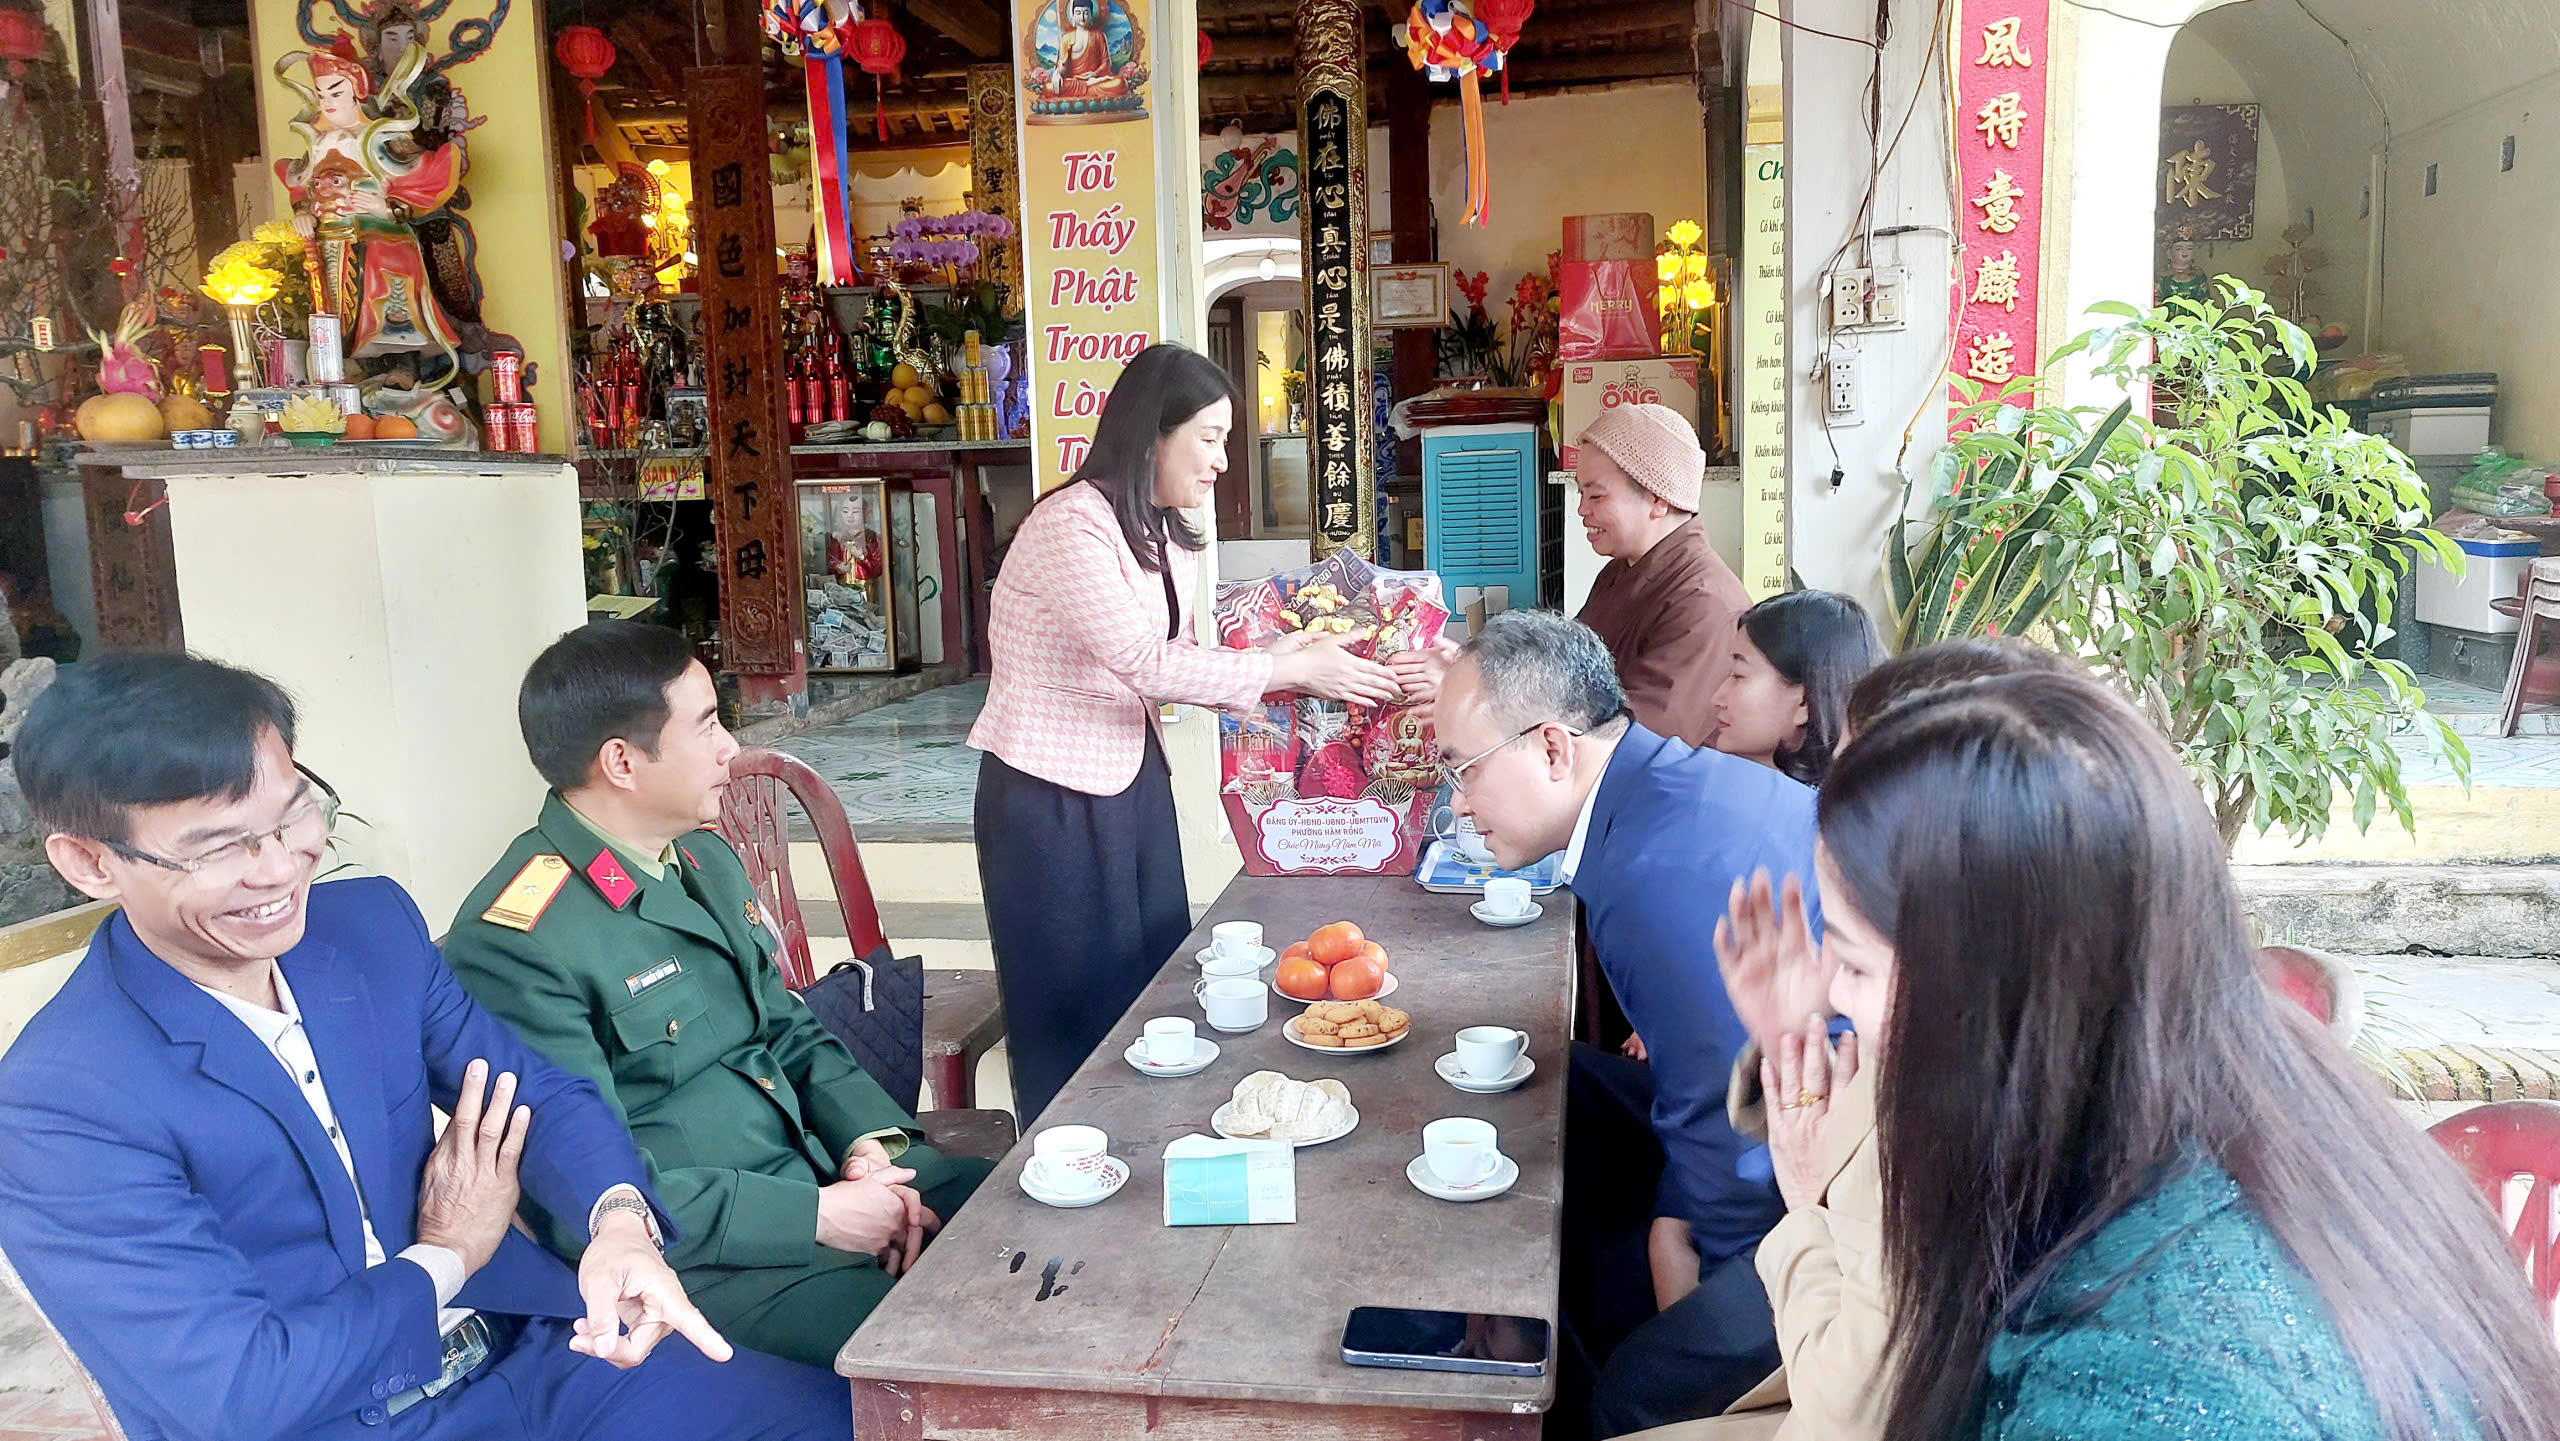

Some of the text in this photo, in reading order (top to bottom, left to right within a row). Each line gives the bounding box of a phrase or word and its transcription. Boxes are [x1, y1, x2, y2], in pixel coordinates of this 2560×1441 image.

[1064, 153, 1116, 191] Tôi
[1049, 205, 1136, 255] Thấy
[1051, 268, 1138, 312] Phật
[1590, 299, 1633, 315] MERRY
[1045, 325, 1148, 366] Trong
